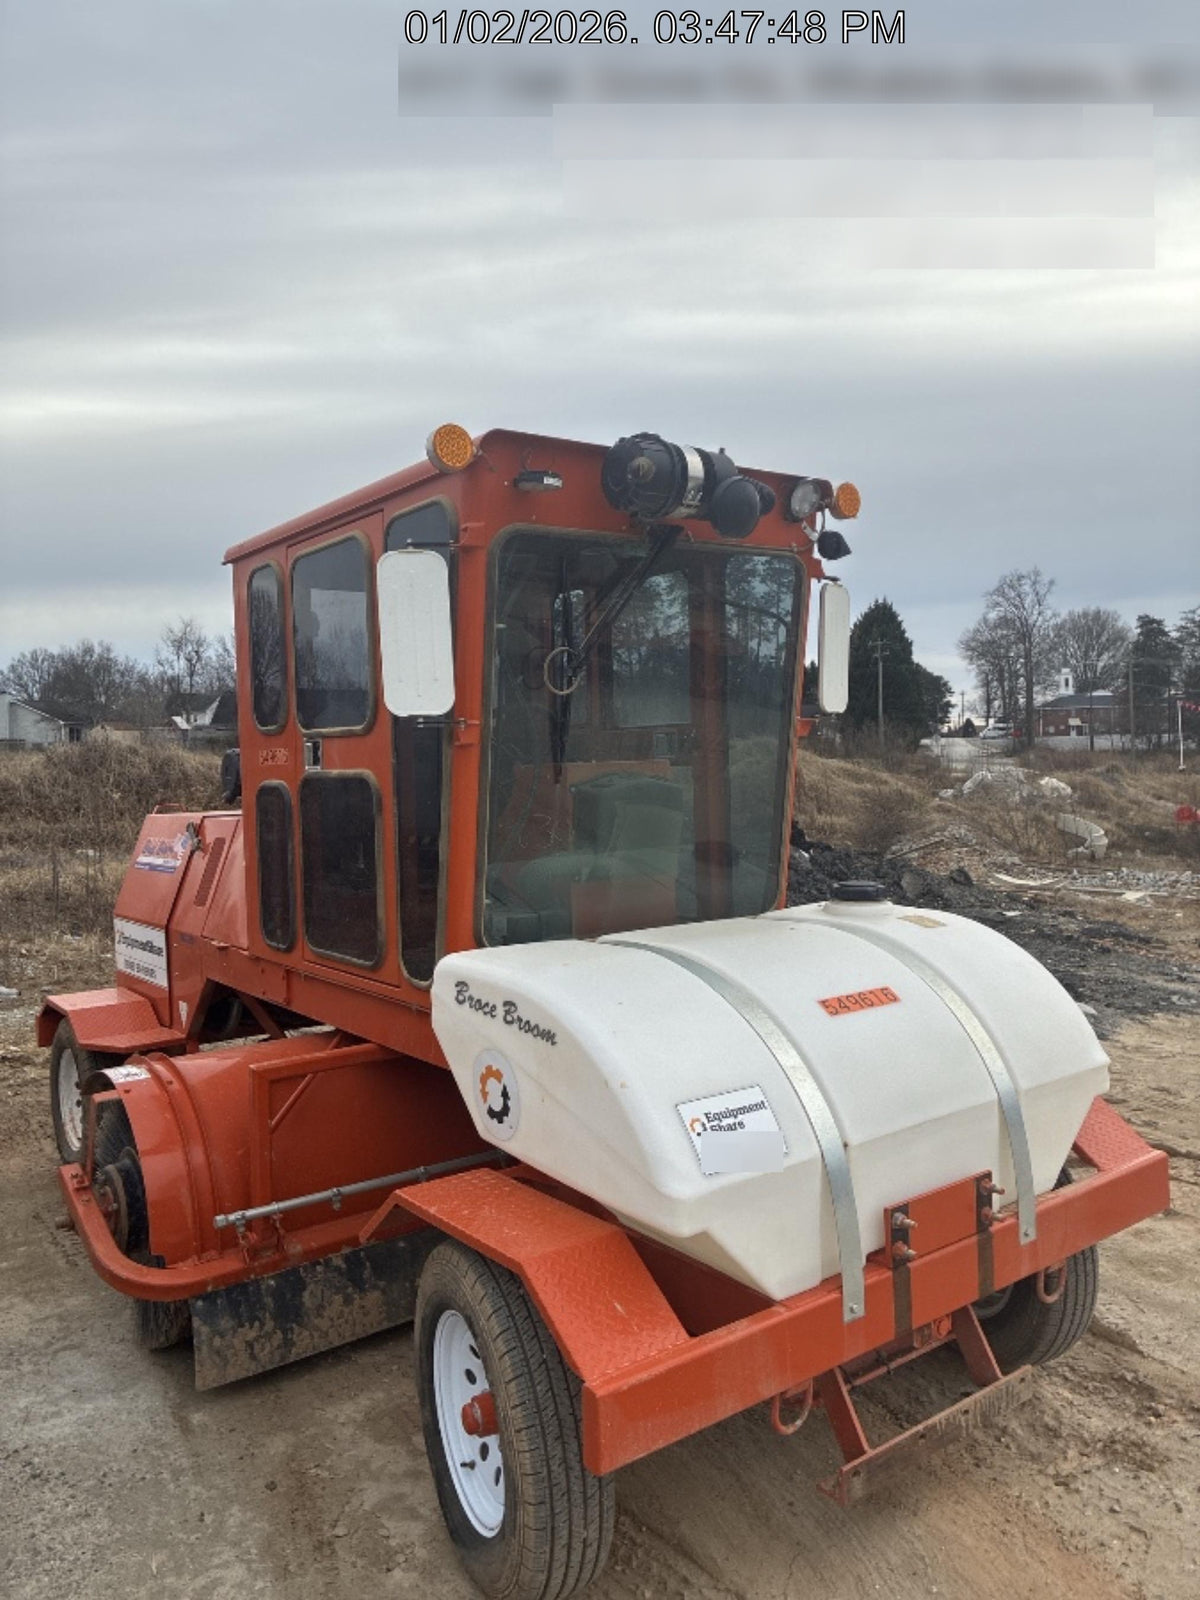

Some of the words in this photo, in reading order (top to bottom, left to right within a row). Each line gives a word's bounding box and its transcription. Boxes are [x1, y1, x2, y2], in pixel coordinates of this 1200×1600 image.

[455, 980, 497, 1018] Broce
[502, 1000, 557, 1046] Broom
[704, 1099, 768, 1124] Equipment
